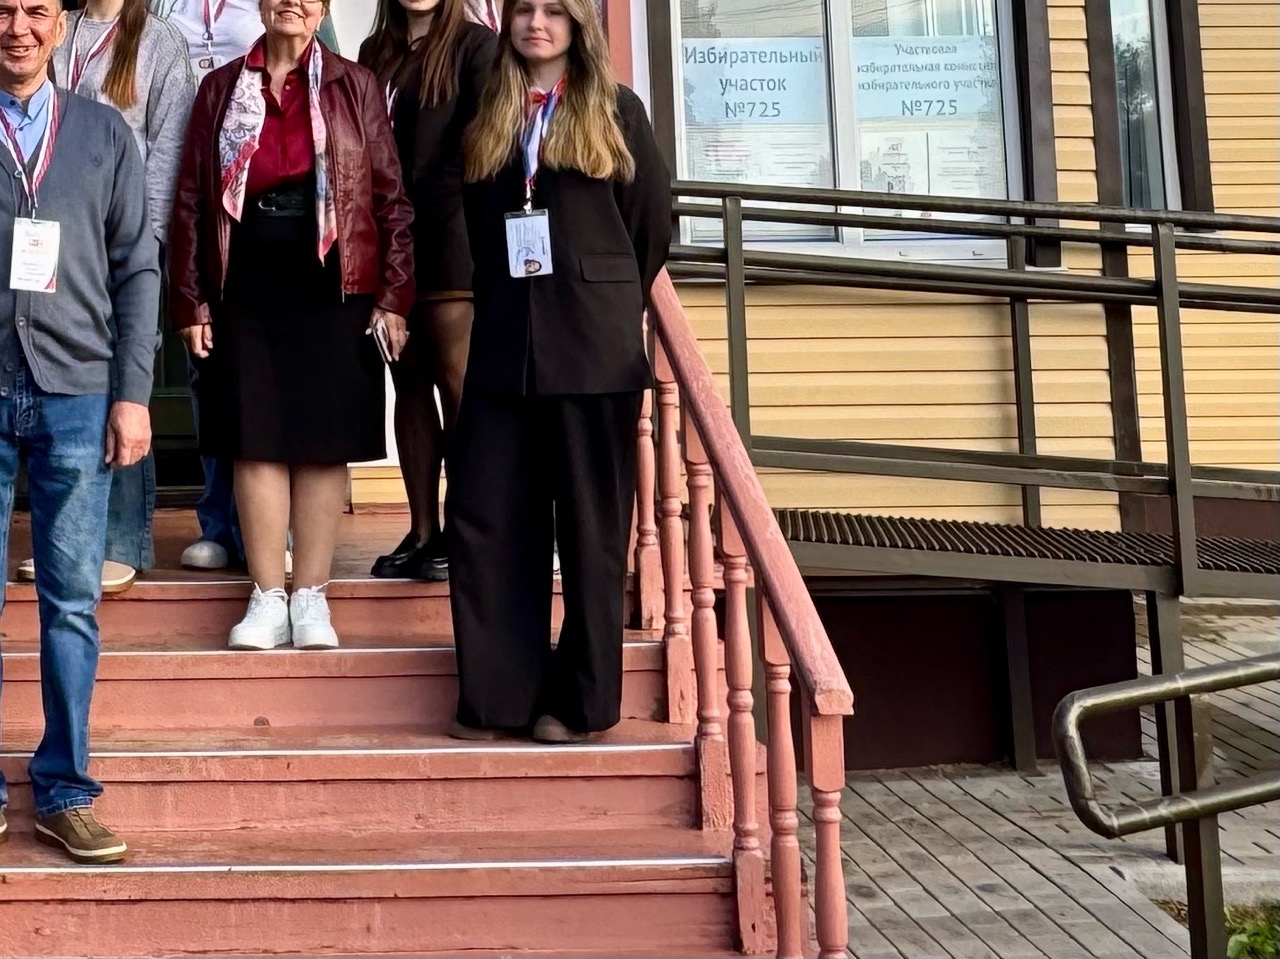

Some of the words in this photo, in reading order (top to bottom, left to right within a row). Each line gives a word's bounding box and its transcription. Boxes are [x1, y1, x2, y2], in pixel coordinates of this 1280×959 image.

[684, 46, 822, 68] Избирательный
[719, 77, 787, 96] участок
[725, 101, 781, 118] №725
[901, 100, 957, 116] №725
